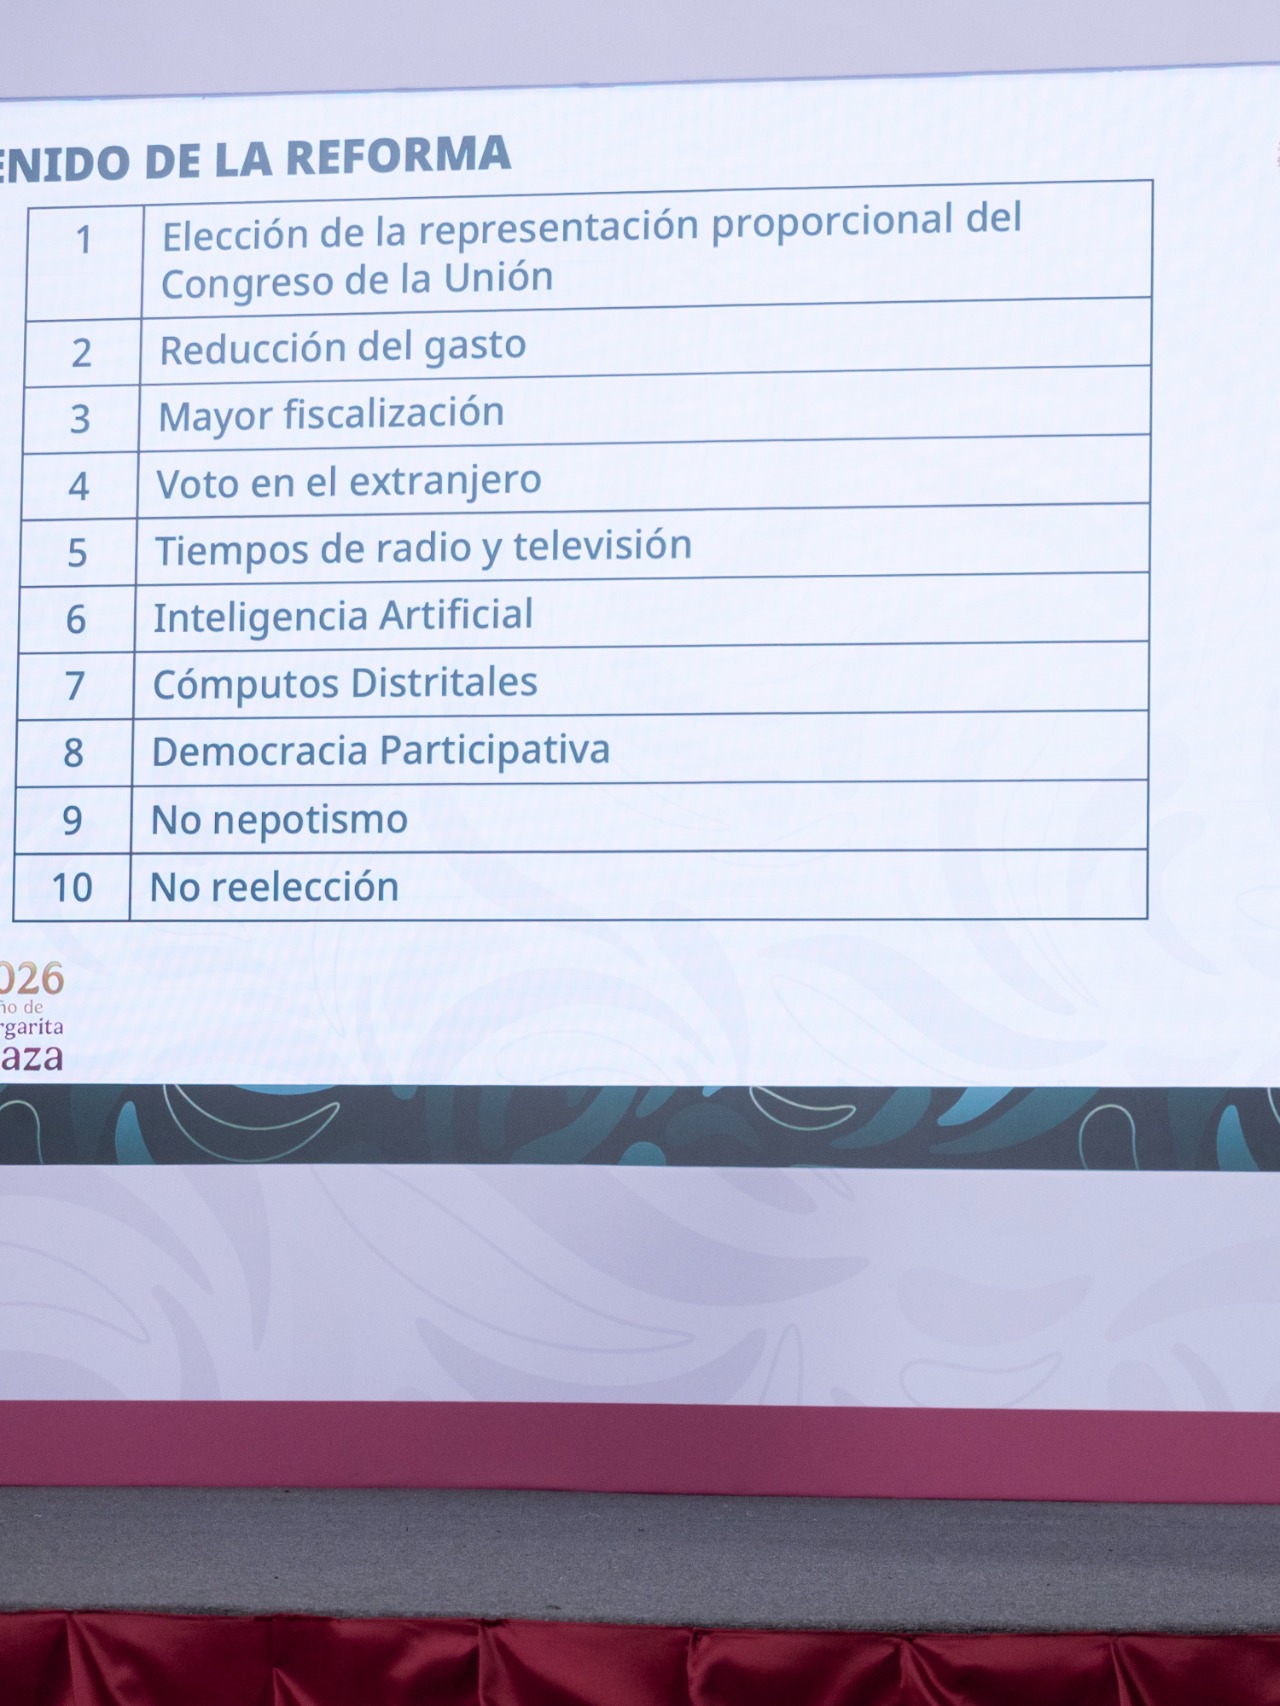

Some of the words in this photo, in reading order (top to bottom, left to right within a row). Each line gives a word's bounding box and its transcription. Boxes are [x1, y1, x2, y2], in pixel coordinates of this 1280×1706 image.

[0, 146, 129, 184] NIDO
[146, 143, 201, 179] DE
[215, 141, 273, 177] LA
[287, 134, 512, 175] REFORMA
[75, 224, 90, 254] 1
[164, 217, 308, 252] Elección
[320, 216, 364, 248] de
[377, 215, 405, 247] la
[420, 207, 698, 254] representación
[713, 201, 952, 248] proporcional
[966, 199, 1021, 233] del
[162, 264, 334, 306] Congreso
[345, 263, 389, 295] de
[402, 262, 430, 294] la
[445, 259, 553, 293] Unión
[72, 337, 92, 368] 2
[161, 330, 346, 366] Reducción
[358, 328, 412, 362] del
[425, 330, 526, 370] gasto
[70, 403, 90, 434] 3
[160, 401, 274, 441] Mayor
[283, 394, 504, 430] fiscalización
[68, 471, 90, 501] 4
[156, 469, 239, 500] Voto
[251, 474, 294, 498] en
[306, 465, 336, 498] el
[350, 463, 542, 504] extranjero
[68, 537, 87, 568] 5
[154, 535, 309, 575] Tiempos
[321, 531, 365, 564] de
[377, 530, 472, 563] radio
[481, 538, 503, 572] y
[513, 527, 691, 561] televisión
[66, 603, 86, 635] 6
[154, 599, 367, 642] Inteligencia
[378, 596, 532, 630] Artificial
[65, 670, 86, 701] 7
[153, 667, 339, 709] Cómputos
[352, 664, 538, 698] Distritales
[63, 737, 84, 768] 8
[153, 734, 367, 767] Democracia
[381, 732, 610, 774] Participativa
[62, 804, 83, 836] 9
[152, 804, 202, 835] No
[213, 802, 408, 844] nepotismo
[52, 871, 93, 903] 10
[151, 871, 201, 903] No
[212, 868, 399, 903] reelección
[24, 1000, 43, 1014] de
